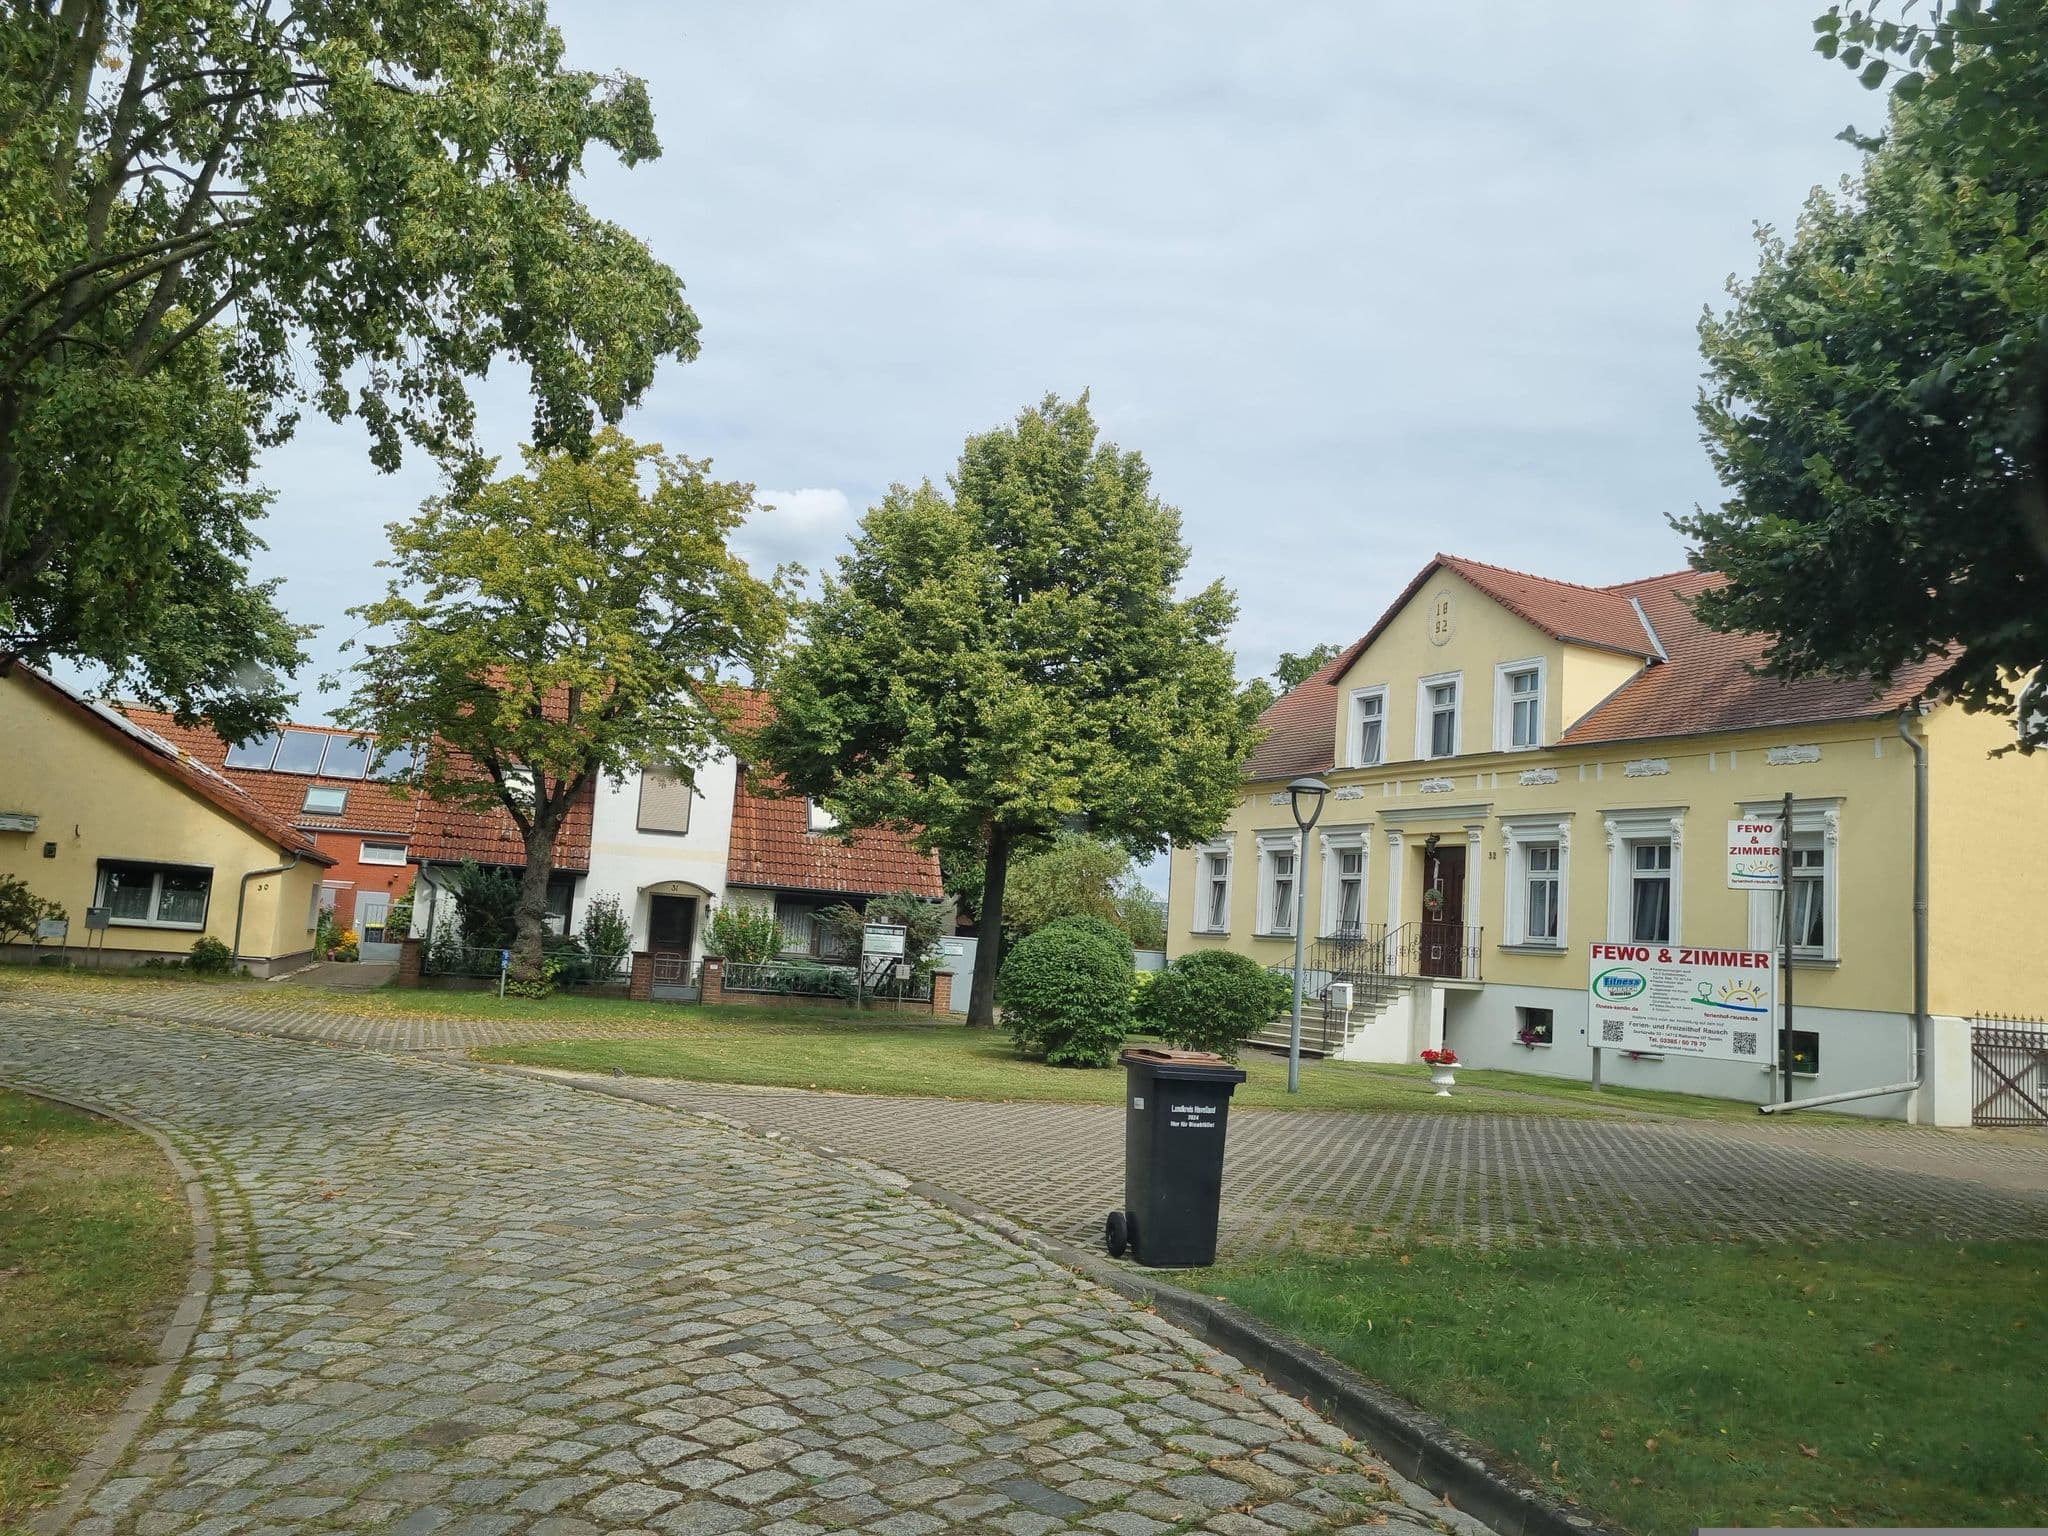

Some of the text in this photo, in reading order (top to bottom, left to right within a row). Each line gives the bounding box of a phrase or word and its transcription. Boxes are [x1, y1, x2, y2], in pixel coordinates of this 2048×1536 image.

[1737, 824, 1773, 833] FEWO
[1750, 836, 1759, 844] &
[1729, 847, 1780, 856] ZIMMER
[257, 883, 269, 892] 30
[1592, 945, 1770, 969] FEWO & ZIMMER
[1604, 977, 1641, 986] Fitness
[1704, 1012, 1758, 1021] ferienhof-rausch.de
[1666, 1024, 1701, 1033] Freizeithof
[1703, 1027, 1728, 1035] Rausch
